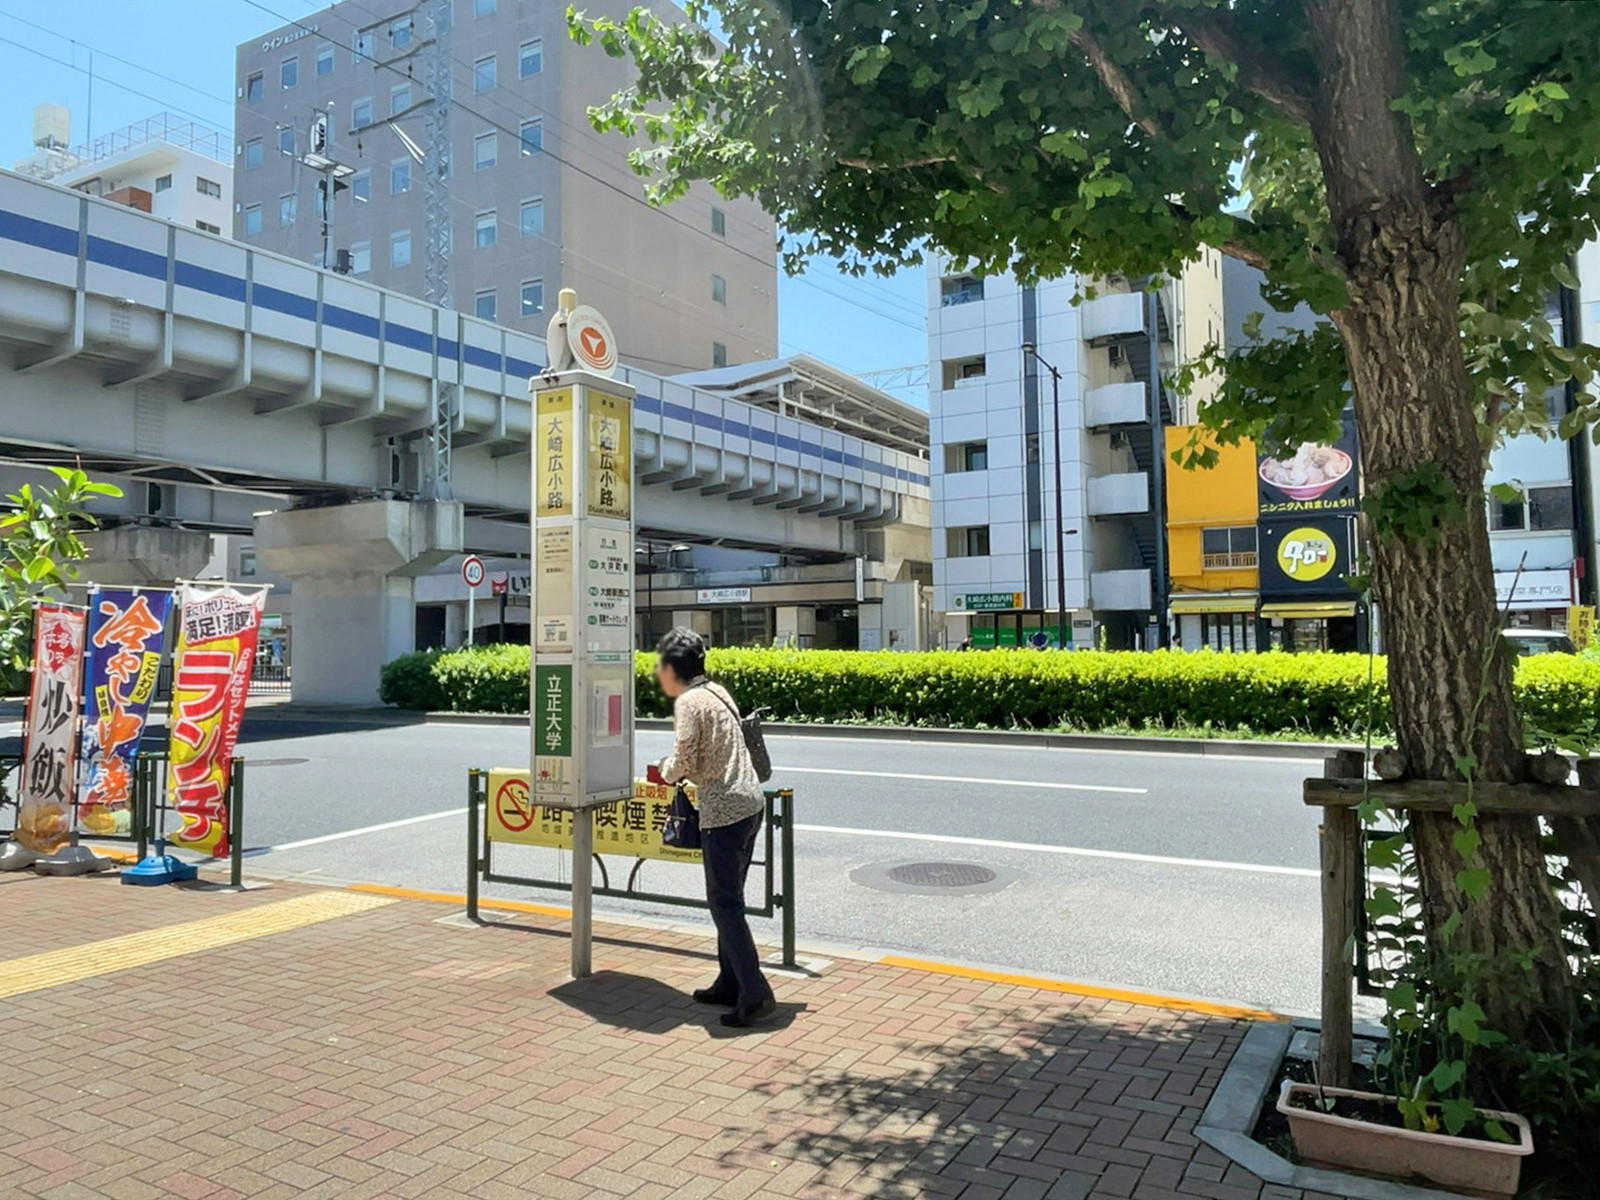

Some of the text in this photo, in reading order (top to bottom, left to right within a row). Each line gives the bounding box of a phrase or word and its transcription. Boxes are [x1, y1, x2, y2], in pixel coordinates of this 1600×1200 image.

[547, 417, 564, 510] 大崎広小路
[467, 565, 480, 579] 40
[92, 595, 163, 808] 冷やし中華
[136, 656, 159, 700] こだわり
[545, 674, 563, 751] 立正大学
[29, 678, 73, 802] 炒飯
[172, 650, 234, 842] ランチ
[542, 801, 671, 832] 路喫煙禁
